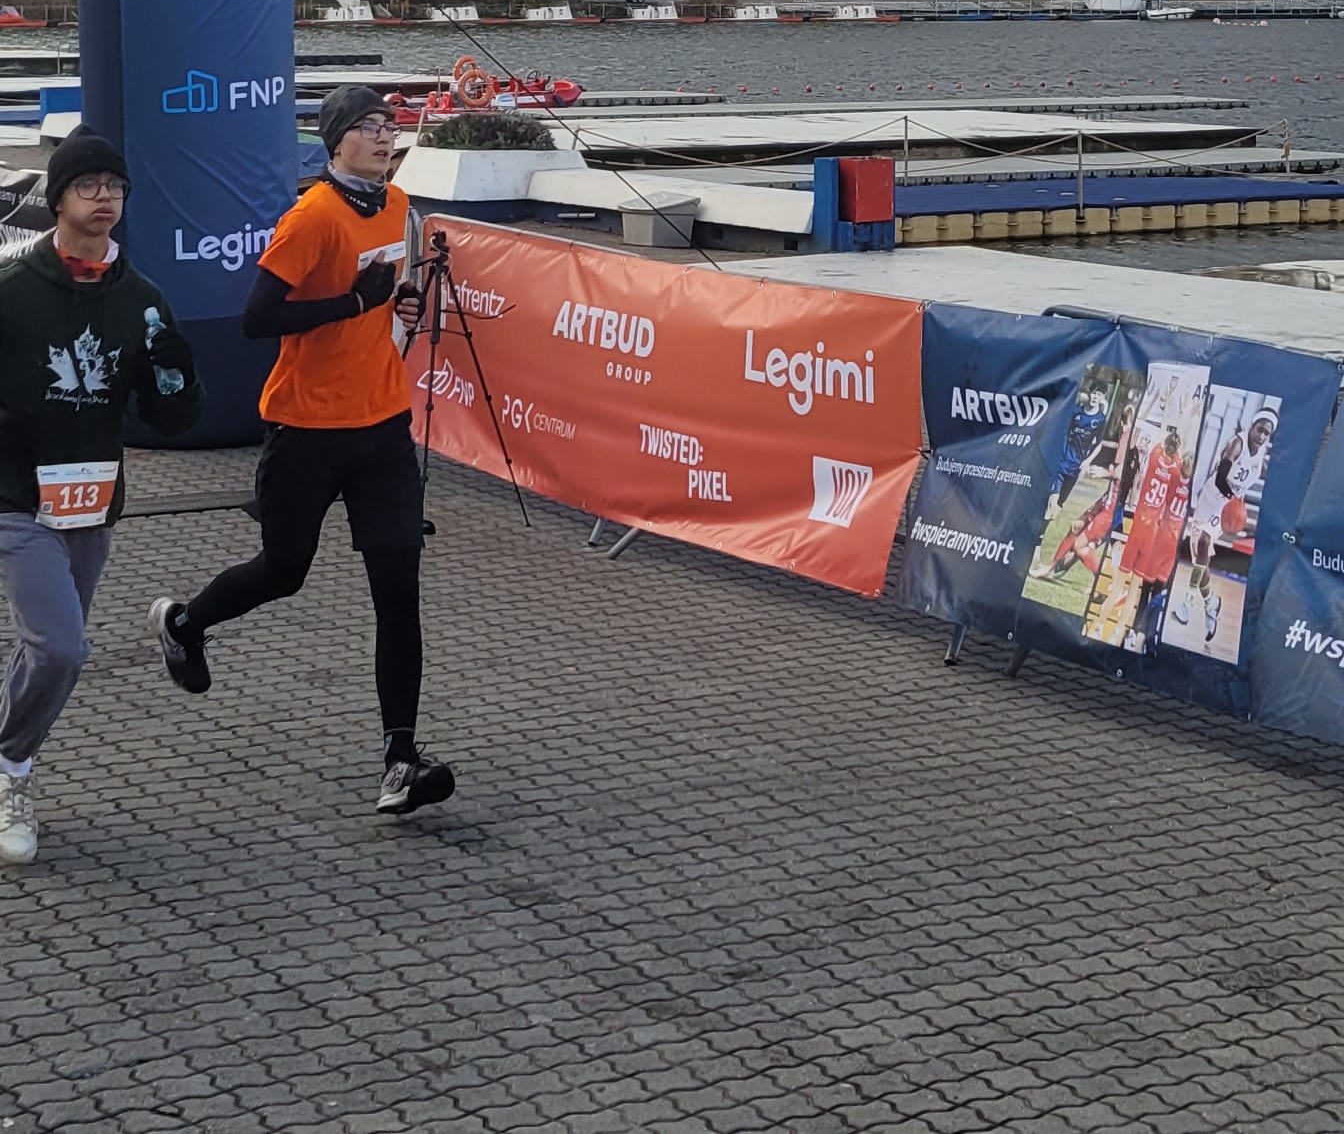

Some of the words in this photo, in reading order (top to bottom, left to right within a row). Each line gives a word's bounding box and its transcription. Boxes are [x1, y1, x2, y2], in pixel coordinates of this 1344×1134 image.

[229, 76, 285, 111] FNP
[174, 222, 278, 272] Legim
[551, 300, 655, 359] ARTBUD
[606, 362, 653, 386] GROUP
[744, 329, 876, 416] Legimi
[446, 375, 475, 408] FNP
[951, 386, 1049, 427] ARTBUD
[502, 394, 534, 434] PGK
[534, 412, 576, 440] CENTRUM
[997, 433, 1031, 448] GROUP
[59, 484, 100, 511] 113
[687, 469, 733, 504] PIXEL
[1145, 477, 1169, 506] 39
[910, 516, 1015, 565] #wspieramysport
